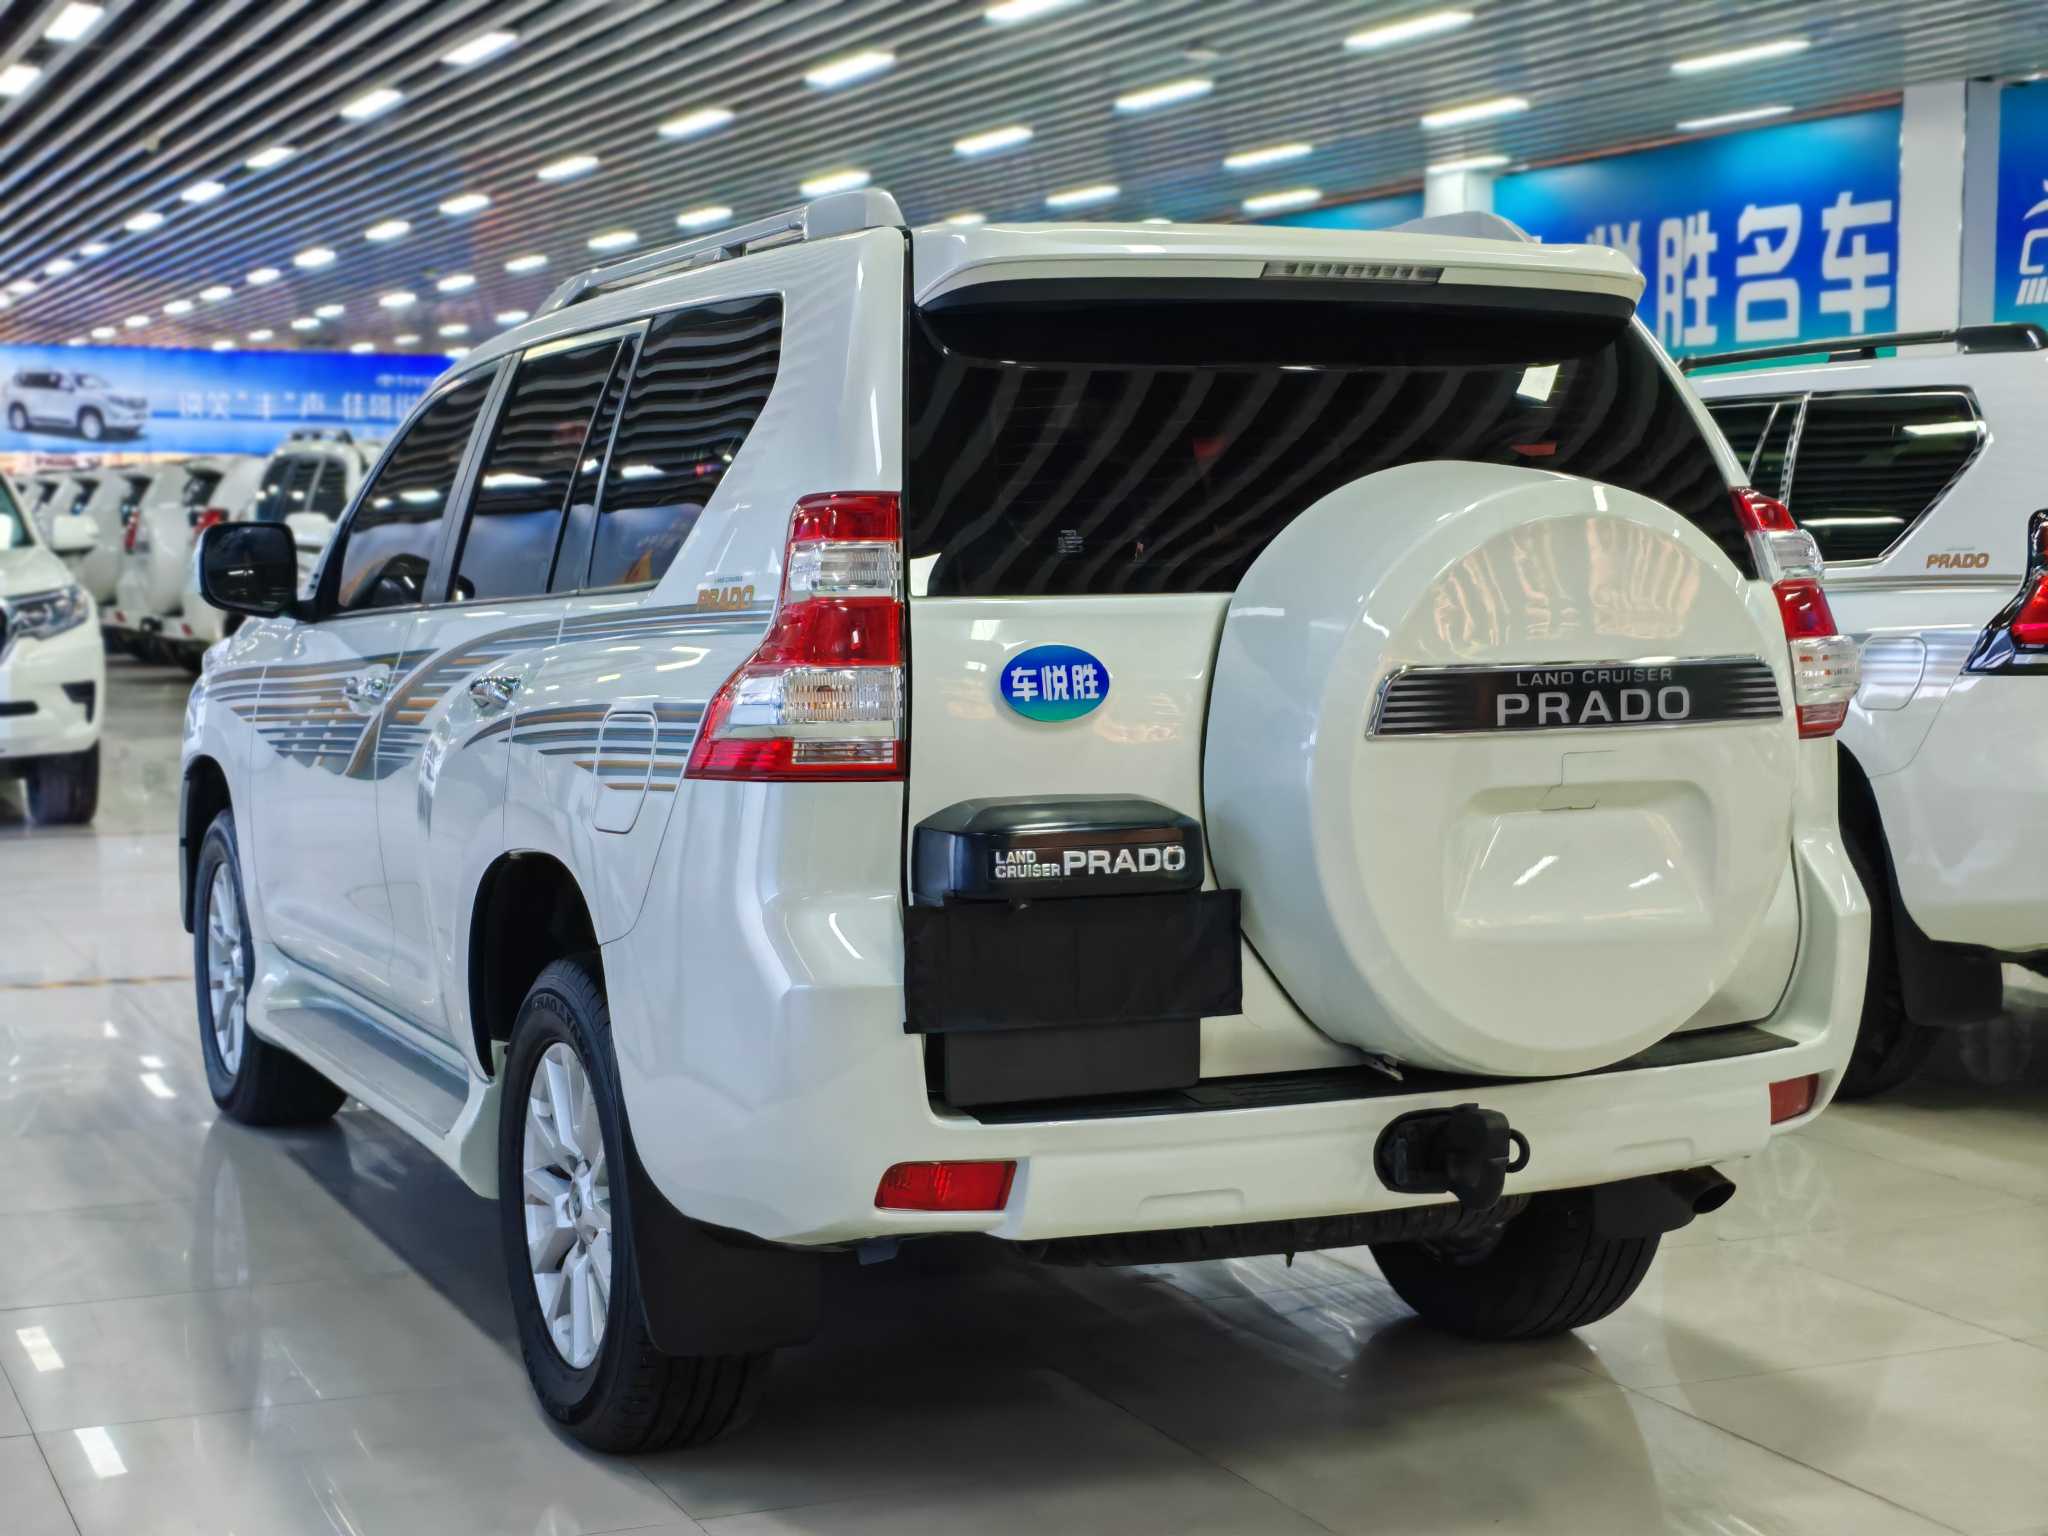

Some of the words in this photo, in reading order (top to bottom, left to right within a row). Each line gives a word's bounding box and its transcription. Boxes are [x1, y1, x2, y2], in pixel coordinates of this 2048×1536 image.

[1926, 552, 1990, 569] PRADO
[698, 585, 754, 610] PRADO
[1010, 663, 1100, 702] 车悦胜
[1516, 671, 1574, 687] LAND
[1581, 667, 1672, 684] CRUISER
[1496, 687, 1690, 726] PRADO
[995, 850, 1036, 864] LAND
[1063, 845, 1186, 876] PRADO
[995, 863, 1061, 878] CRUISER
